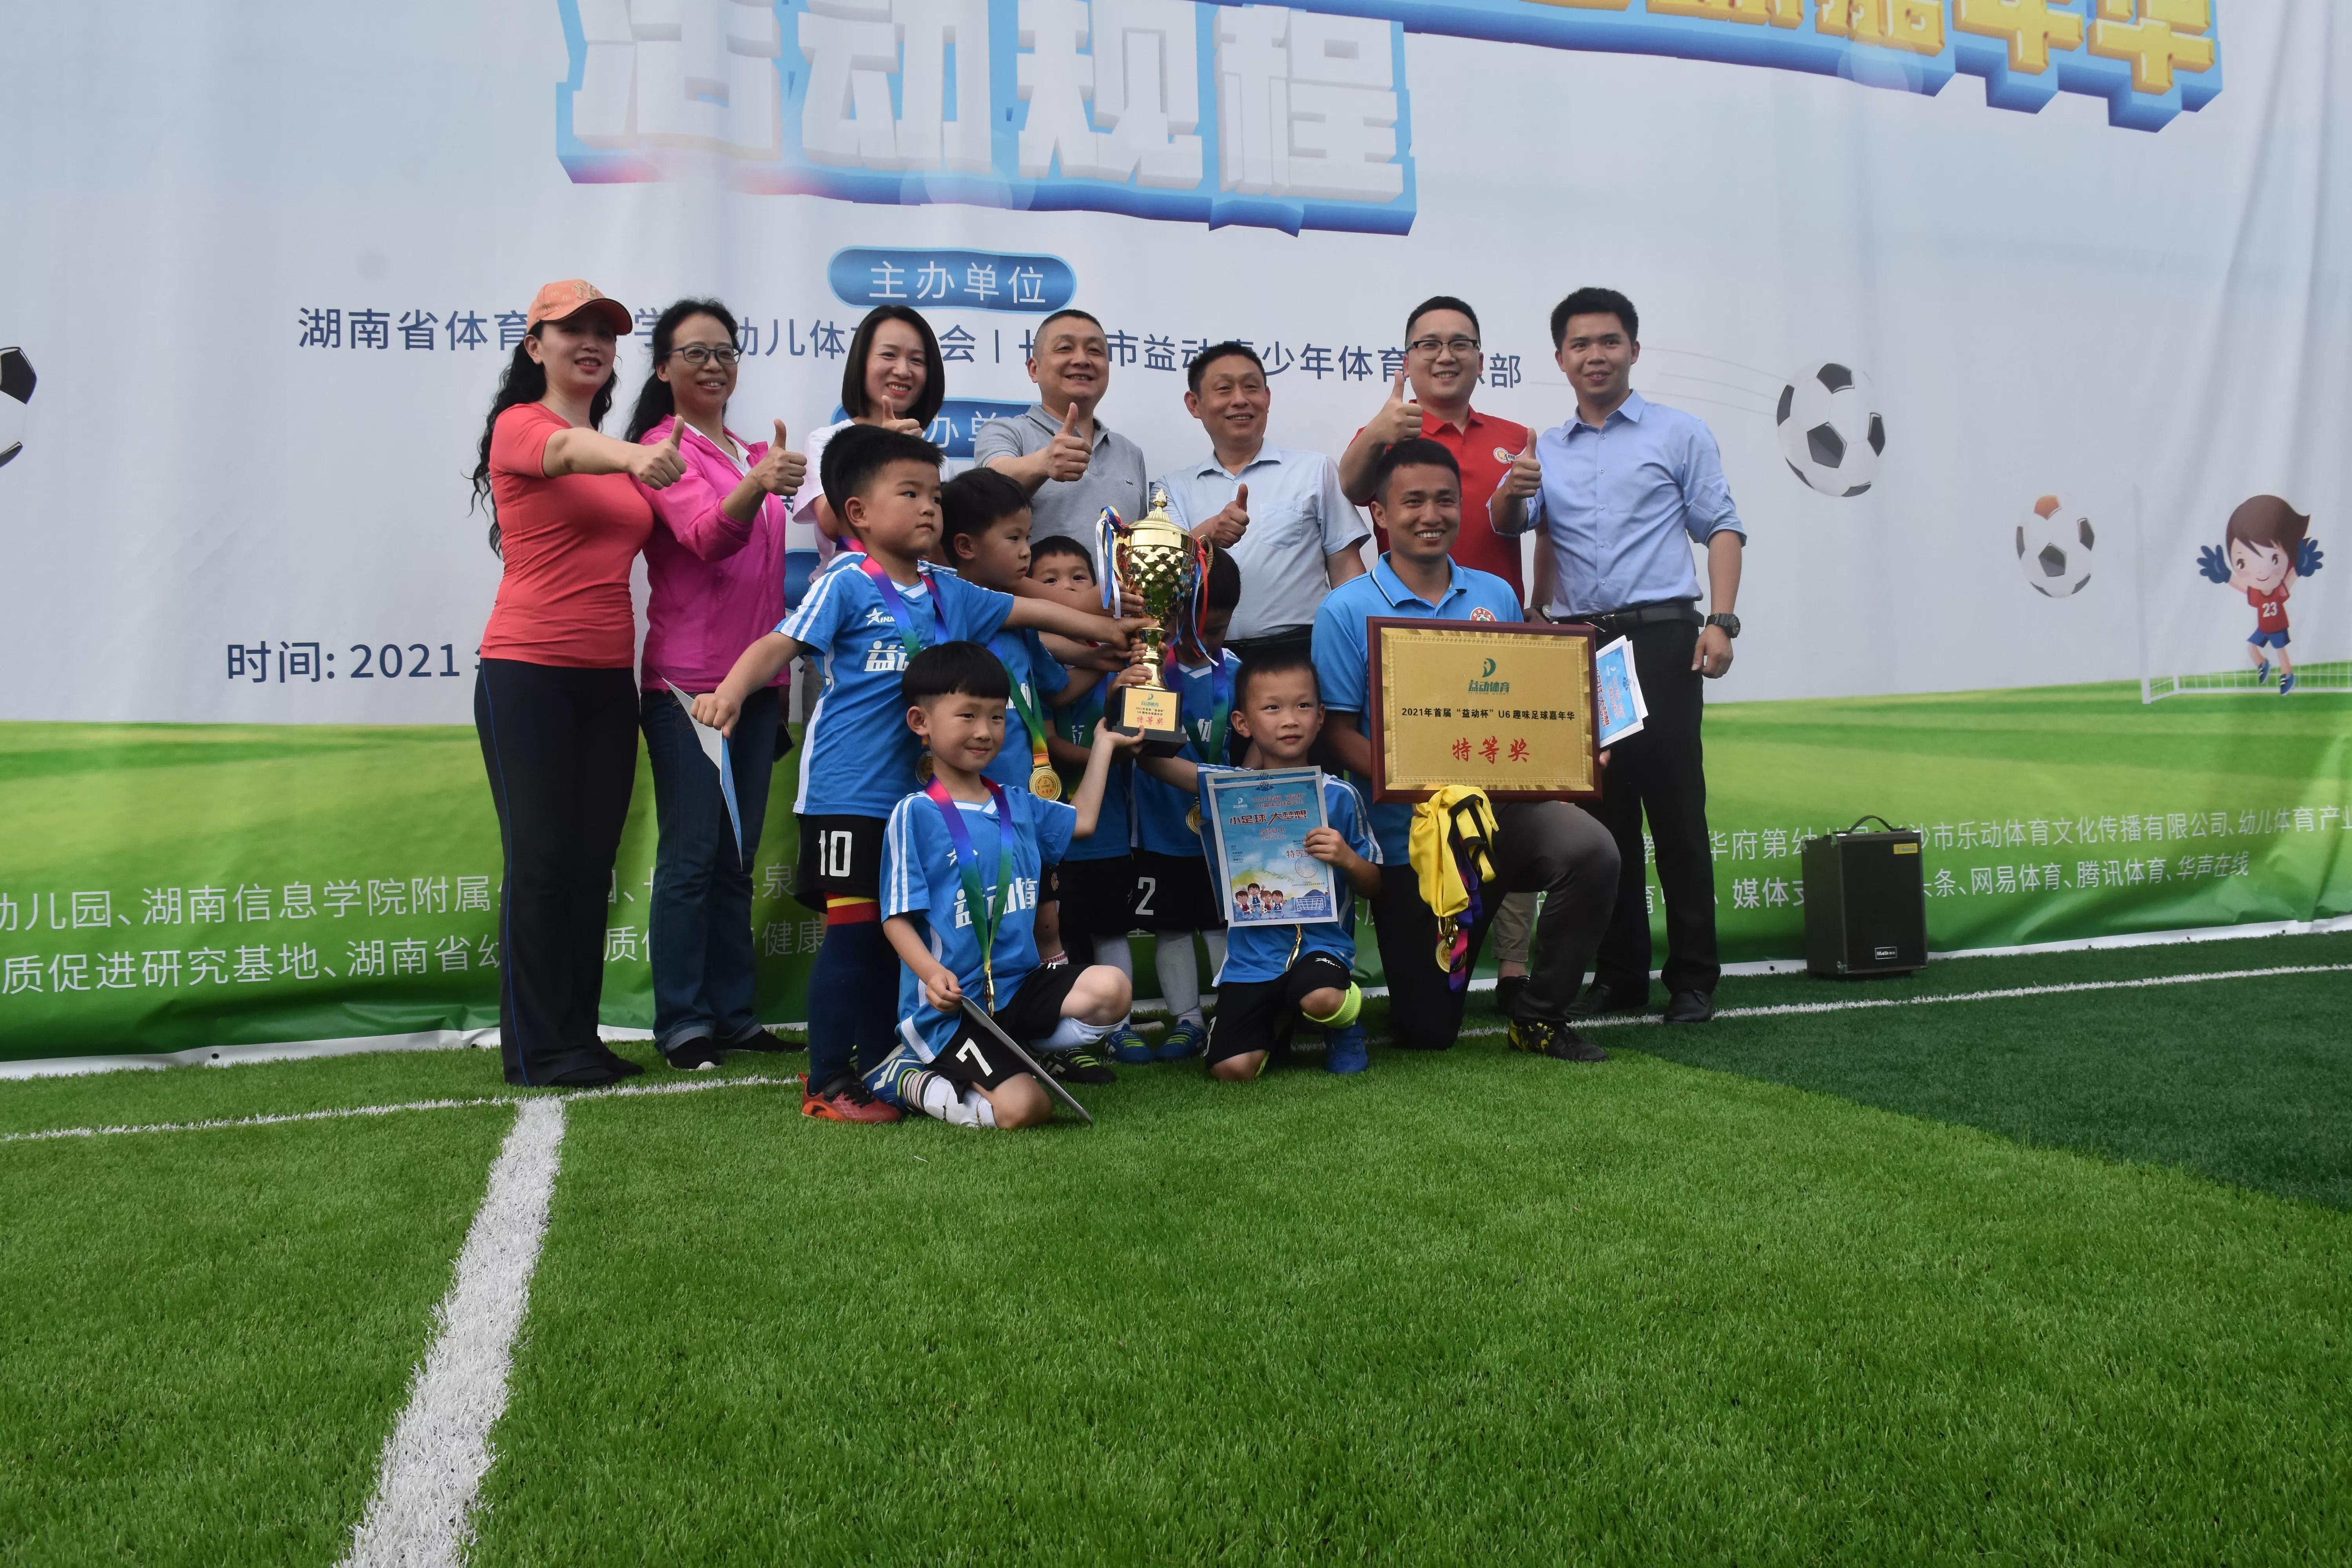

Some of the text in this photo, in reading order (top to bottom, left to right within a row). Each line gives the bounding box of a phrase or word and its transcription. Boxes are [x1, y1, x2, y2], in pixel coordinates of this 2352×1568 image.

[869, 260, 1046, 304] 主办单位
[2262, 602, 2278, 618] 23
[350, 643, 460, 679] 2021
[1468, 679, 1511, 693] 益动体育
[1136, 715, 1164, 725] 特等奖
[1452, 735, 1531, 764] 特等奖
[1229, 809, 1308, 826] 小足球 大梦想
[818, 830, 852, 877] 10
[1135, 877, 1156, 916] 2
[955, 1037, 993, 1077] 7
